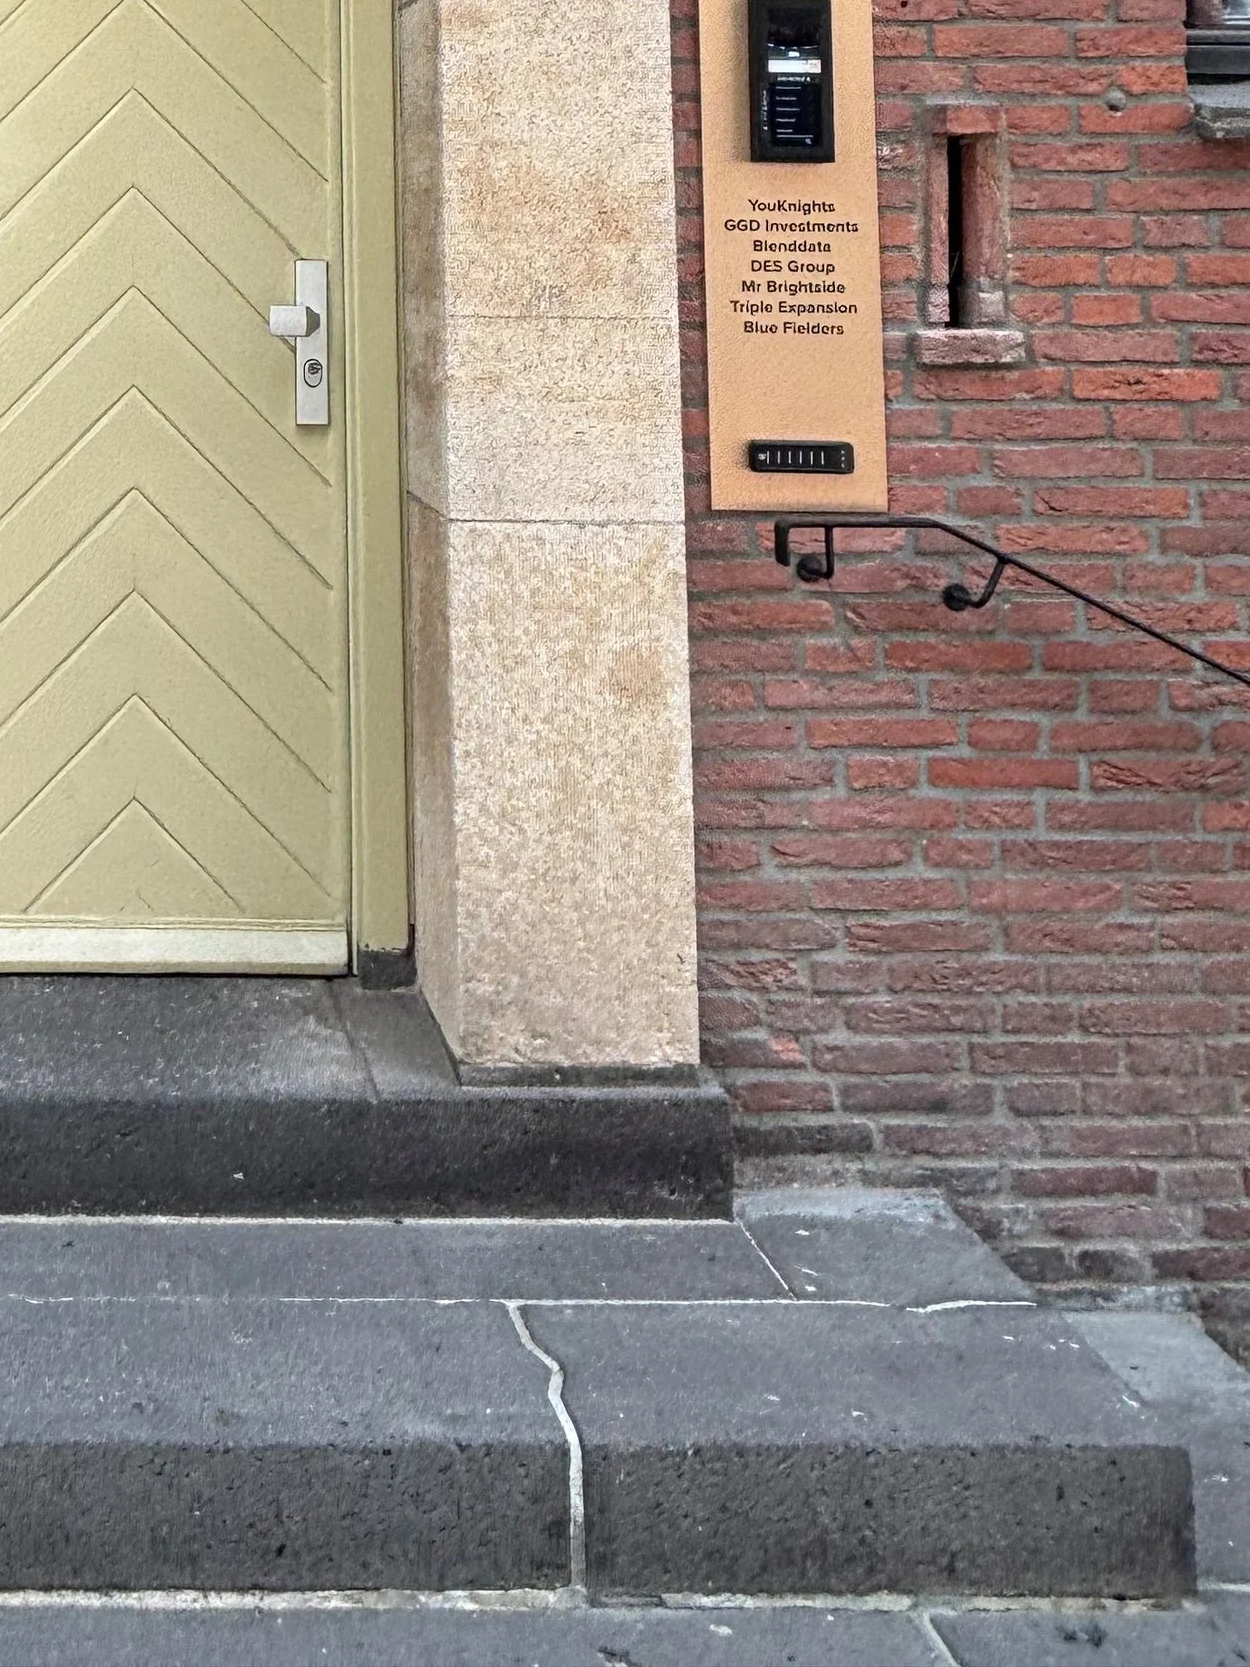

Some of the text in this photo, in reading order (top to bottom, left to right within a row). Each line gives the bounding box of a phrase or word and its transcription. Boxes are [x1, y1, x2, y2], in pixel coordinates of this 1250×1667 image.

[748, 198, 836, 216] YouKnights
[724, 219, 859, 233] GGD Investments
[753, 239, 832, 253] Blenddata
[751, 260, 836, 275] DES Group
[741, 280, 846, 296] Mr Brightside
[730, 300, 858, 316] Triple Expansion
[743, 320, 845, 335] Blue Fielders
